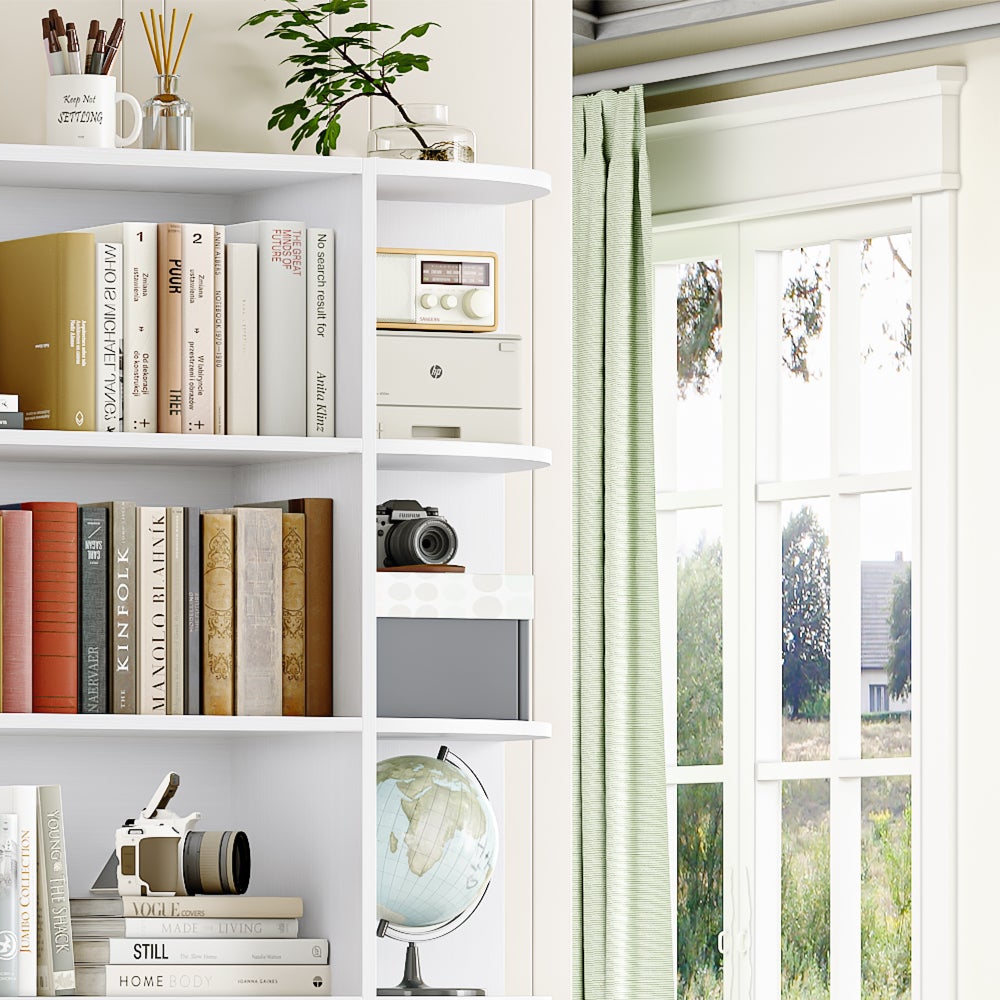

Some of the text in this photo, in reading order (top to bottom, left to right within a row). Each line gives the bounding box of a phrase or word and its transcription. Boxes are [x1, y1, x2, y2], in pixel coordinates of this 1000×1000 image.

[57, 110, 103, 125] SETTLING
[63, 94, 96, 107] Keep Not
[136, 231, 144, 242] 1
[192, 233, 203, 244] 2
[271, 229, 282, 263] FUTURE
[282, 229, 292, 270] MINDS OF
[292, 230, 302, 277] THE GREAT
[168, 259, 182, 294] PUUR
[317, 233, 327, 338] No search result for
[215, 290, 223, 329] NOTEBOOK
[132, 350, 140, 397] do konstrukcji
[141, 353, 150, 395] Od dekoracji
[187, 341, 195, 376] przestrzeni
[196, 355, 205, 396] W labiryncie
[316, 371, 327, 432] Anita Klinz
[84, 540, 103, 550] SAGAN
[87, 550, 101, 560] CARL
[116, 547, 129, 672] KINFOLK
[148, 515, 165, 712] MANOLO BLAHNÍK
[87, 646, 99, 712] NAERVAER
[47, 809, 62, 861] YOUNG
[50, 874, 70, 954] THE SHACK
[132, 902, 206, 918] VOGUE COVERS
[161, 922, 198, 934] MADE
[218, 923, 263, 934] LIVING
[19, 911, 31, 953] JUMBO
[133, 943, 169, 960] STILL
